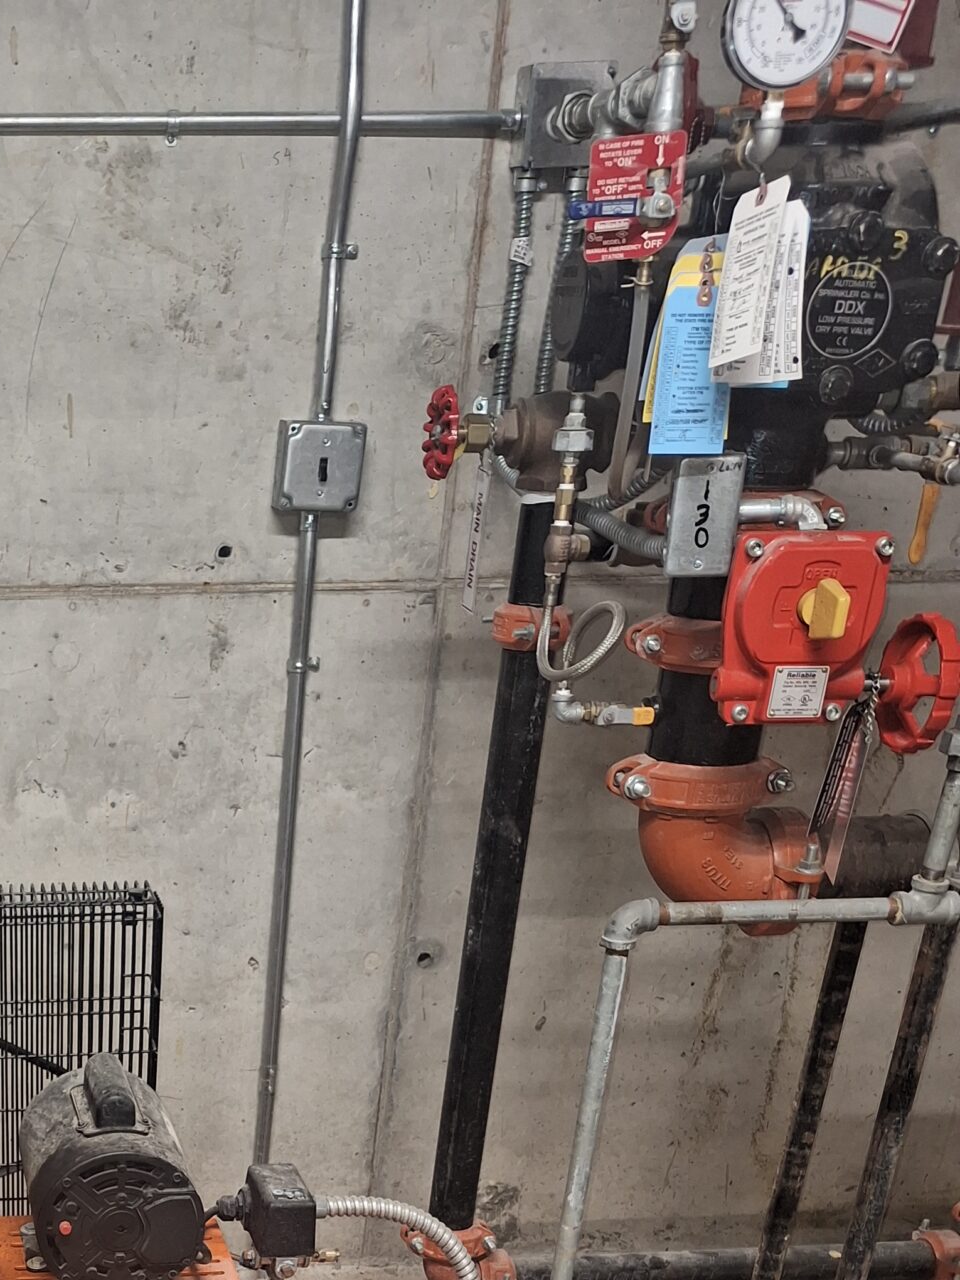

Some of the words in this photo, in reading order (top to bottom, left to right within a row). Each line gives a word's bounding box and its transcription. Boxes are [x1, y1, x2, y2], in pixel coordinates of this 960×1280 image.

[654, 135, 670, 145] ON
[643, 239, 663, 249] OFF
[834, 279, 877, 289] AUTOMATIC
[818, 288, 860, 298] SPRINKLER
[833, 300, 867, 315] DDX
[818, 315, 836, 323] LOW
[836, 316, 876, 325] PRESSURE
[815, 325, 831, 333] DRY
[832, 326, 849, 334] PIPE
[850, 327, 874, 335] VALVE
[473, 492, 484, 533] MAIN
[467, 541, 478, 589] DRAIN
